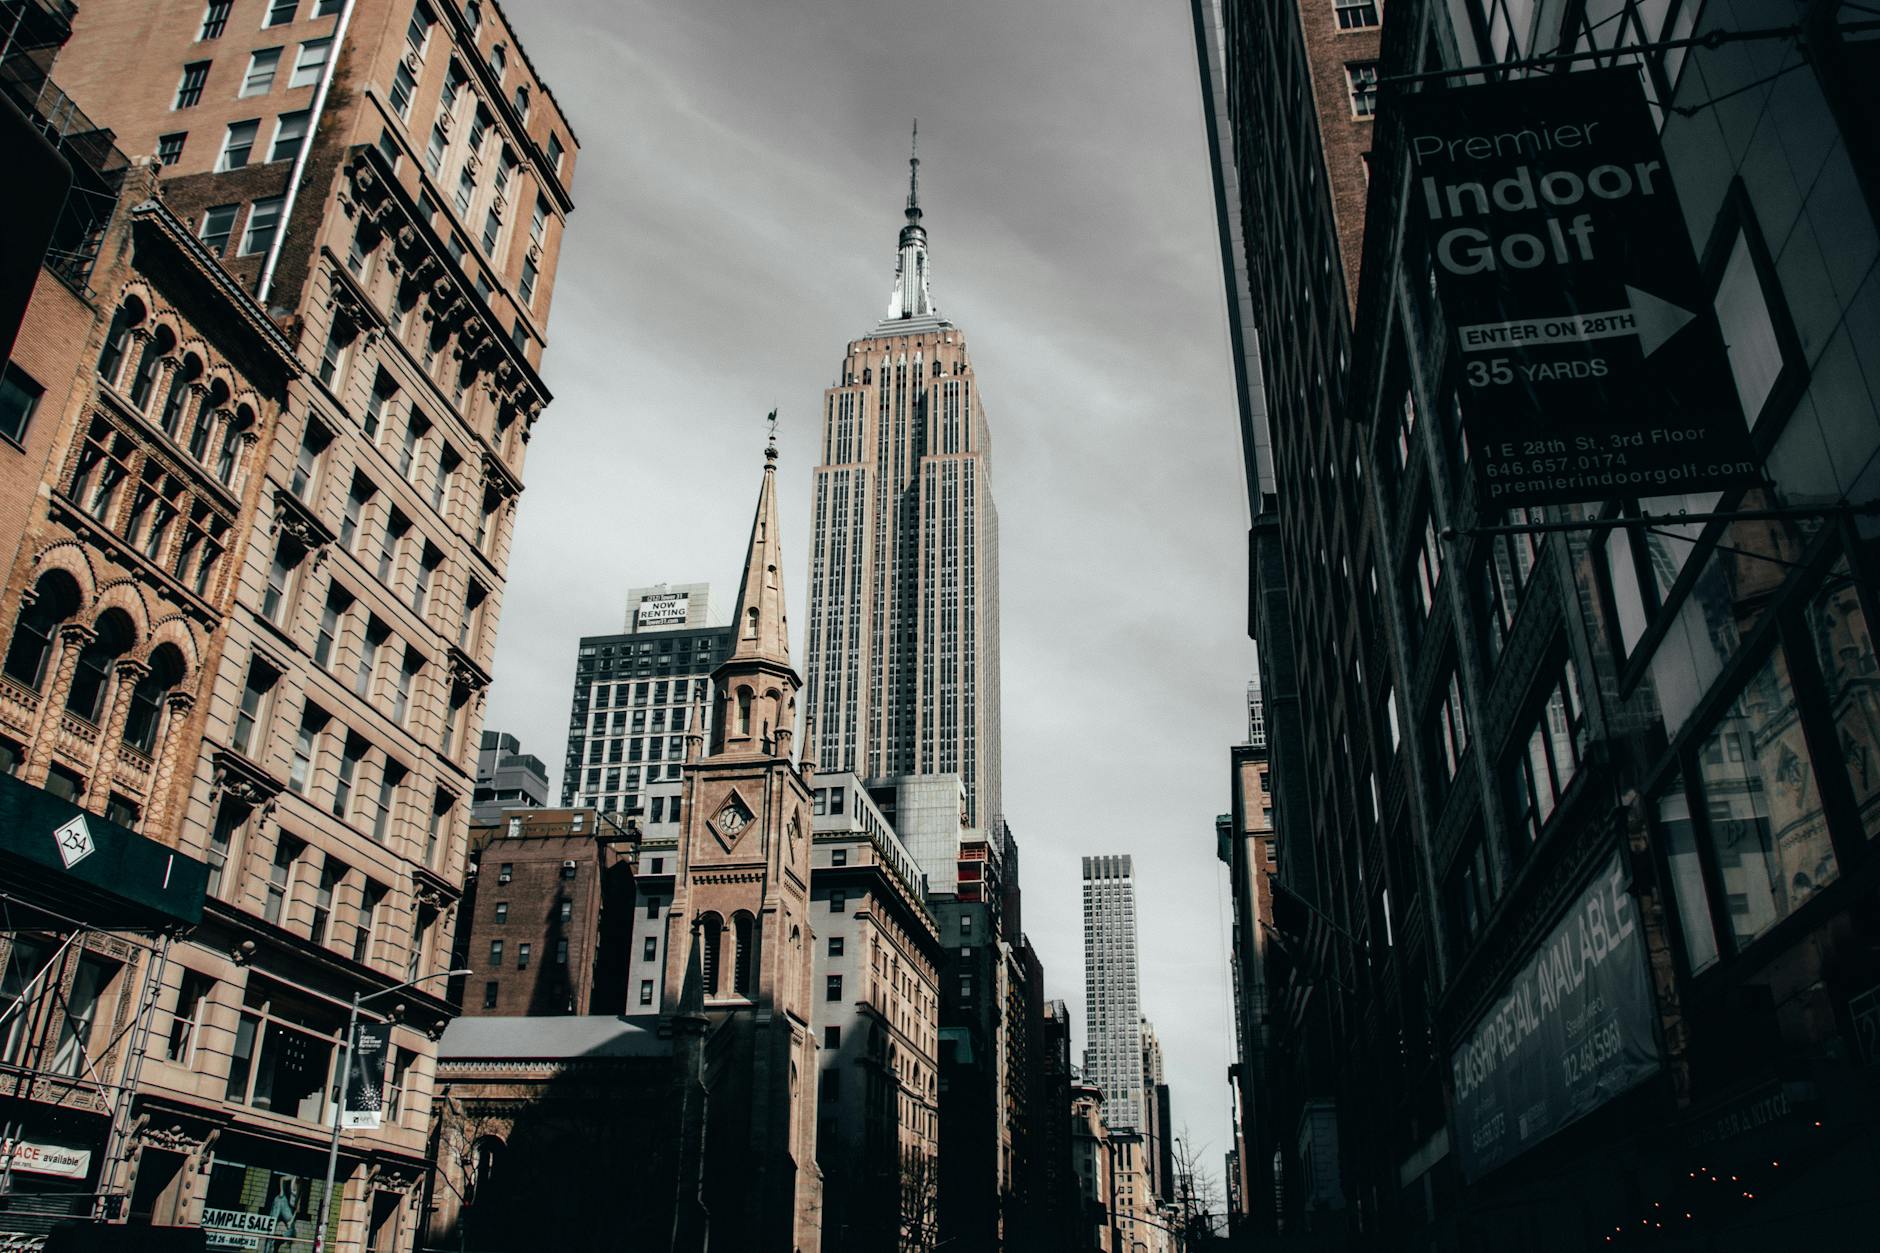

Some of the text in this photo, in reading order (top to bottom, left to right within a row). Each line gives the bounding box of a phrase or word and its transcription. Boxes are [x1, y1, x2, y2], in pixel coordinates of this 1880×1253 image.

[1412, 120, 1599, 166] Premier
[1421, 159, 1662, 220] Indoor
[1436, 213, 1595, 275] Golf
[1466, 314, 1637, 345] ENTER ON 28TH
[1465, 357, 1609, 388] 35 YARDS
[1483, 444, 1492, 459] 1
[1500, 442, 1516, 457] E
[1522, 439, 1567, 456] 28th
[1609, 432, 1644, 448] 3rd
[1650, 428, 1706, 444] Floor
[1486, 453, 1627, 477] 646.657.0174
[1490, 461, 1755, 498] premierindoorgolf.com
[640, 608, 686, 618] RENTING
[652, 601, 676, 610] NOW
[62, 829, 87, 854] 254
[1453, 1026, 1497, 1105] FLAGSHIP
[1495, 981, 1539, 1062] RETAIL
[1537, 867, 1634, 1023] AVAILABLE
[43, 1153, 80, 1167] available
[201, 1209, 275, 1232] SAMPLE SALE
